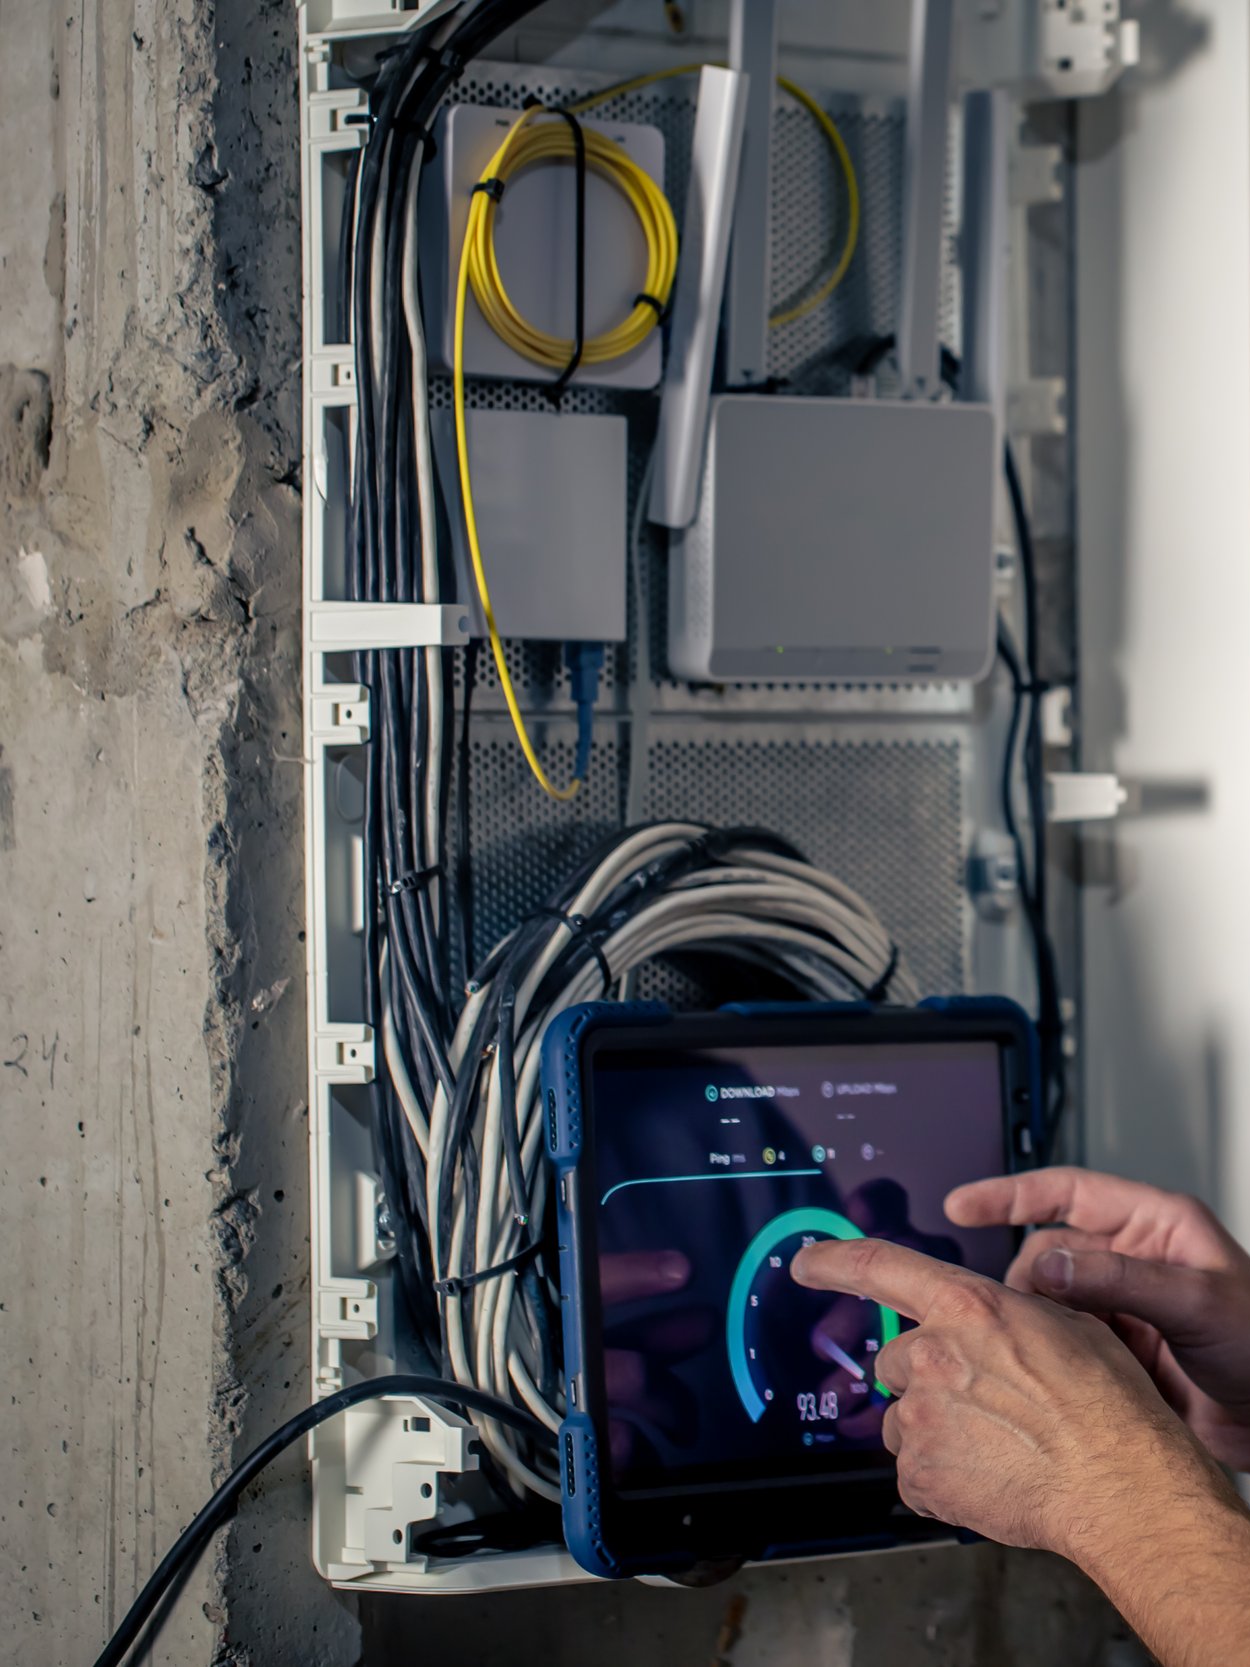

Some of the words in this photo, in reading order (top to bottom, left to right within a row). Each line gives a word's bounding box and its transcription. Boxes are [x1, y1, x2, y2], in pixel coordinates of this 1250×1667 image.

[720, 1085, 775, 1099] DOWNLOAD
[837, 1083, 873, 1094] UPLOAD
[709, 1153, 731, 1165] Ping
[769, 1256, 782, 1268] 10
[751, 1296, 758, 1307] 5
[750, 1348, 755, 1359] 1
[764, 1389, 774, 1400] 0
[796, 1390, 838, 1421] 93.48
